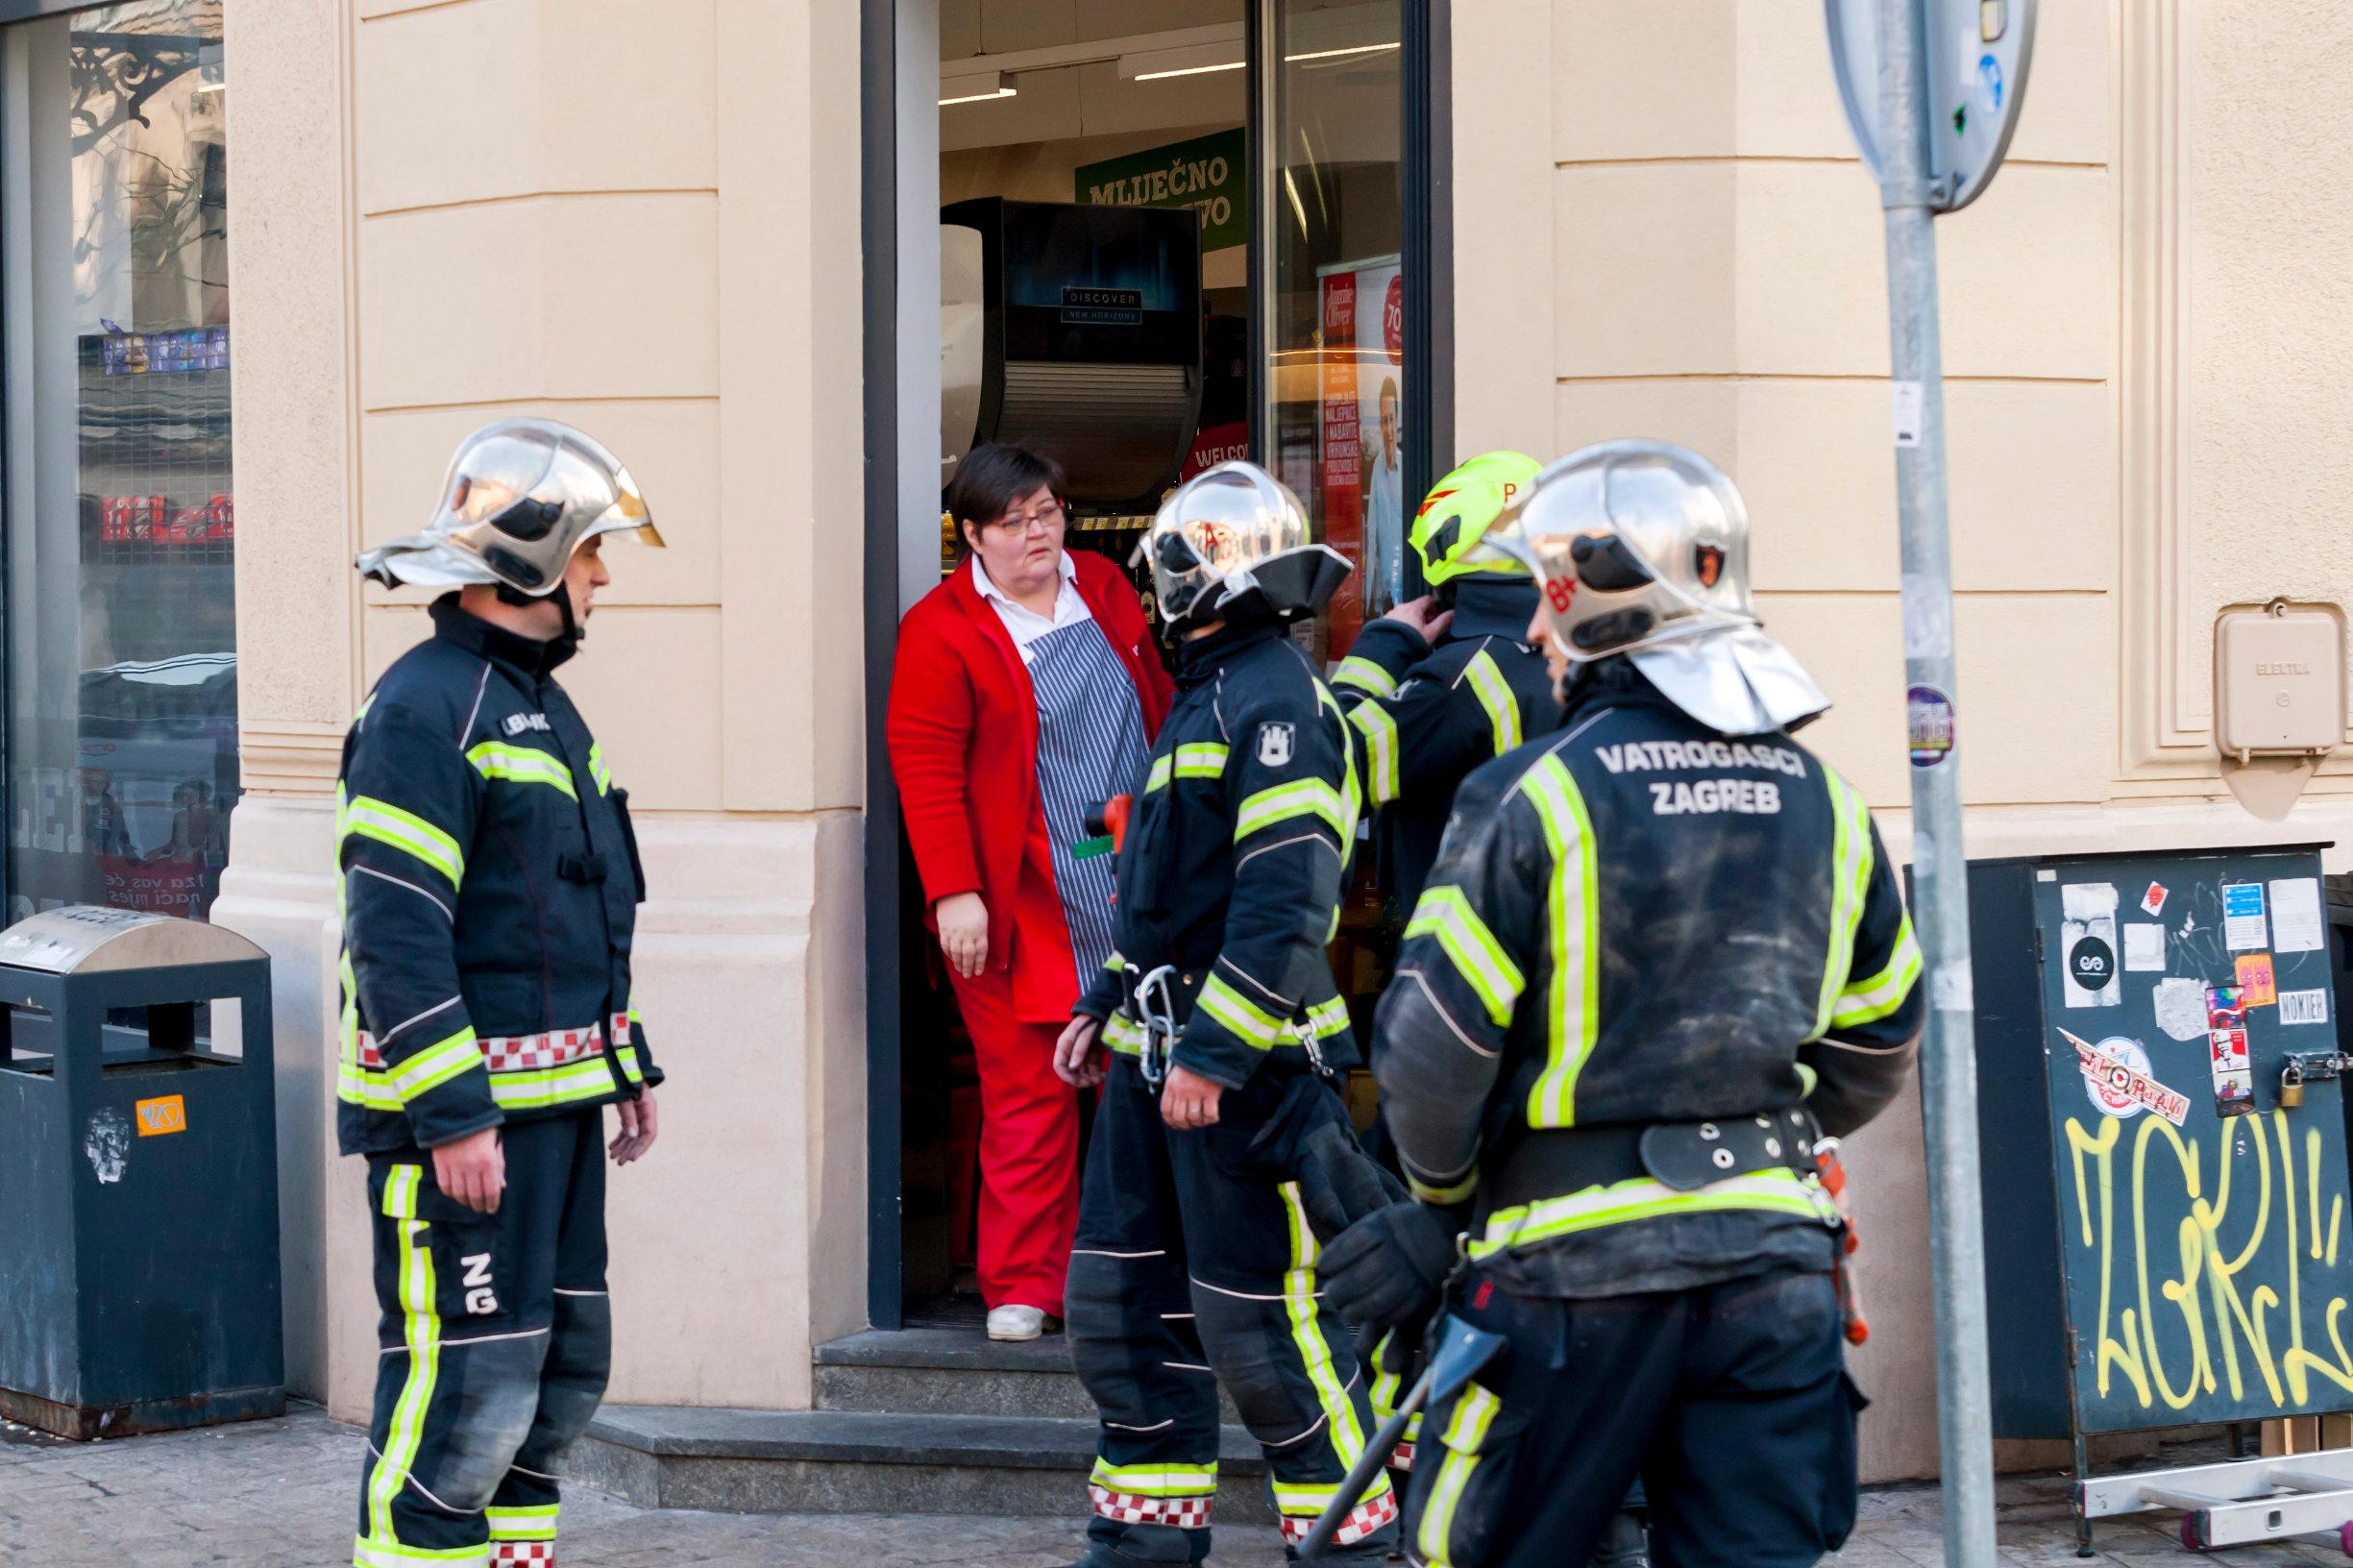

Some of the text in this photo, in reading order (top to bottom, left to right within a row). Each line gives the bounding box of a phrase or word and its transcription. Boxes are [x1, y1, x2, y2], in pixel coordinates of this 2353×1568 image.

[1090, 157, 1228, 206] MLIJEČNO
[1070, 293, 1135, 304] DISCOVER
[1069, 310, 1136, 320] NEW HORIZONS
[1196, 444, 1249, 468] WELCO
[1595, 741, 1807, 779] VATROGASCI
[1649, 778, 1781, 815] ZAGREB
